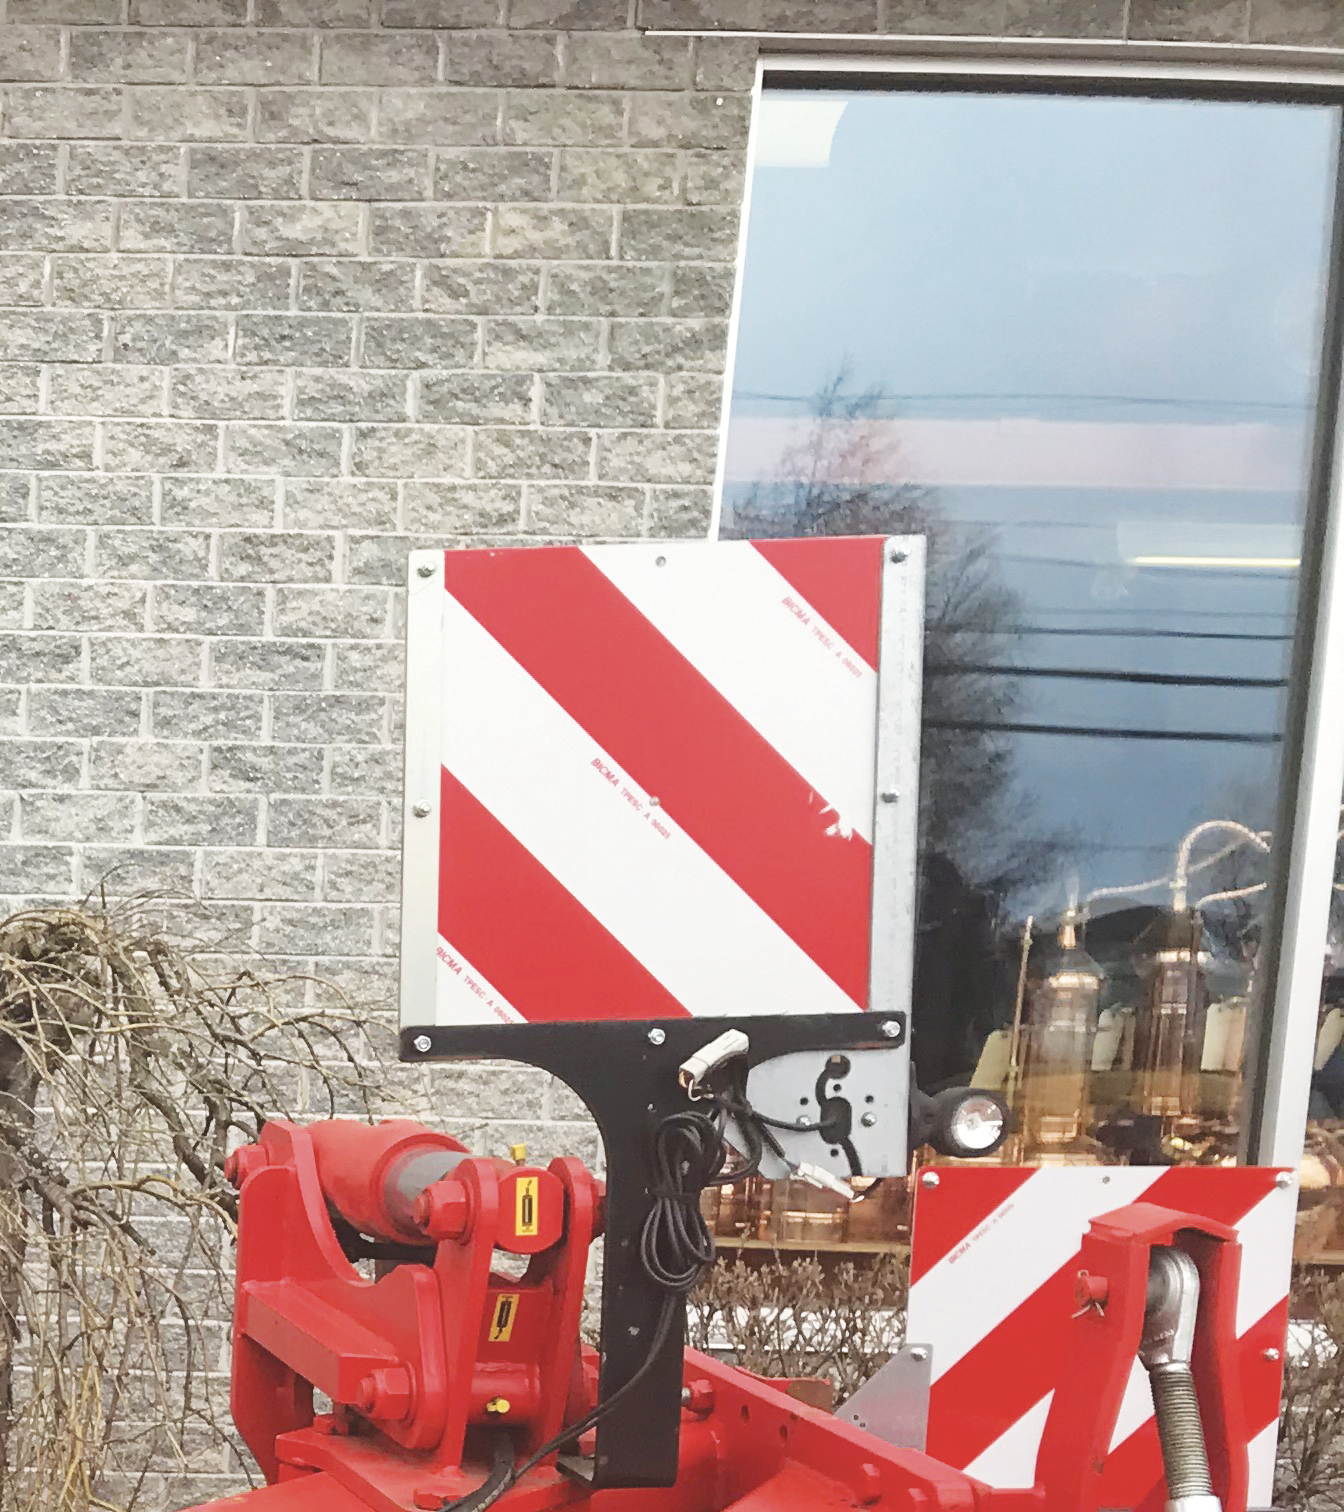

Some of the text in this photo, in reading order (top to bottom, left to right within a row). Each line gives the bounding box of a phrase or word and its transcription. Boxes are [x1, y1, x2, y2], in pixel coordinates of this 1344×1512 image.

[782, 597, 810, 625] BICMA
[591, 758, 619, 787] BICMA
[436, 946, 463, 975] BICMA
